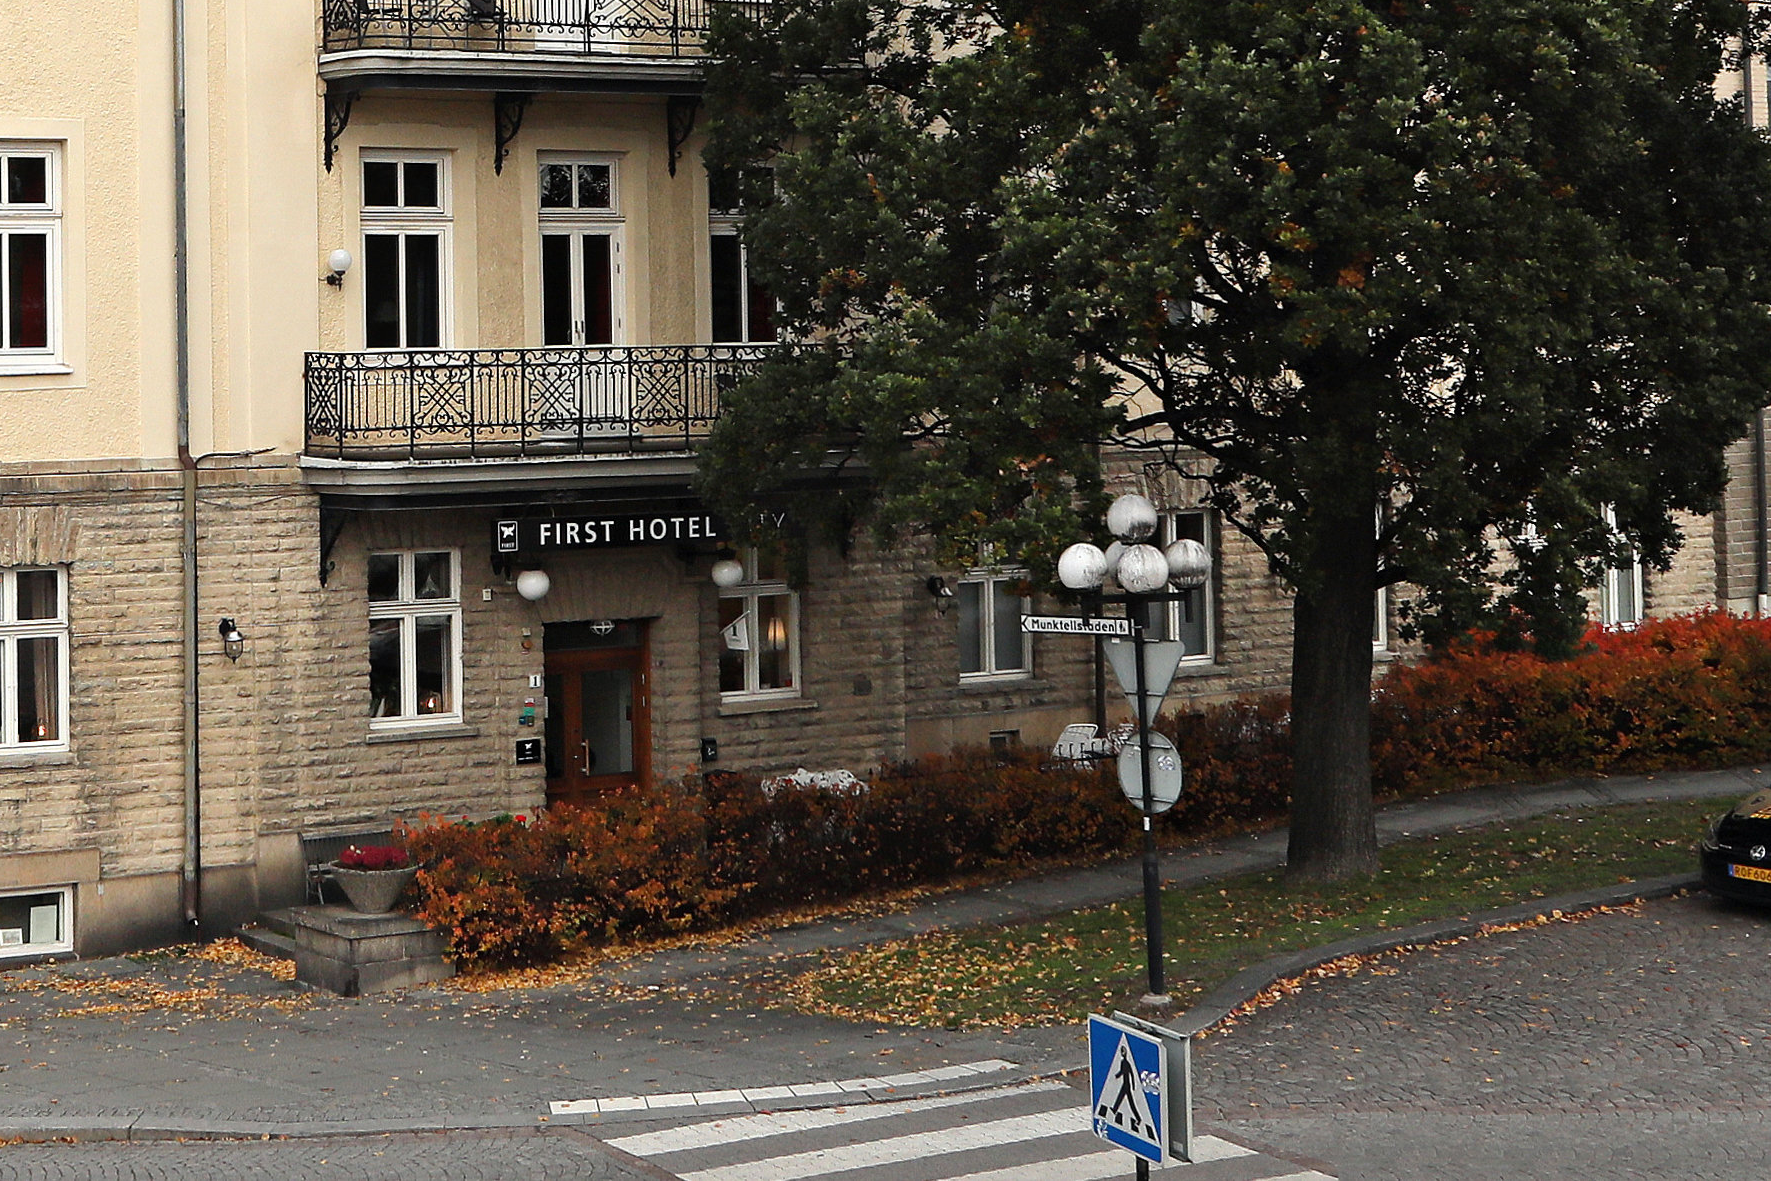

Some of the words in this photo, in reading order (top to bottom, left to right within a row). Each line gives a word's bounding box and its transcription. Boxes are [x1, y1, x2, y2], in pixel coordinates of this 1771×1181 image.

[539, 520, 615, 546] FIRST
[629, 516, 717, 541] HOTEL
[532, 675, 539, 687] 1
